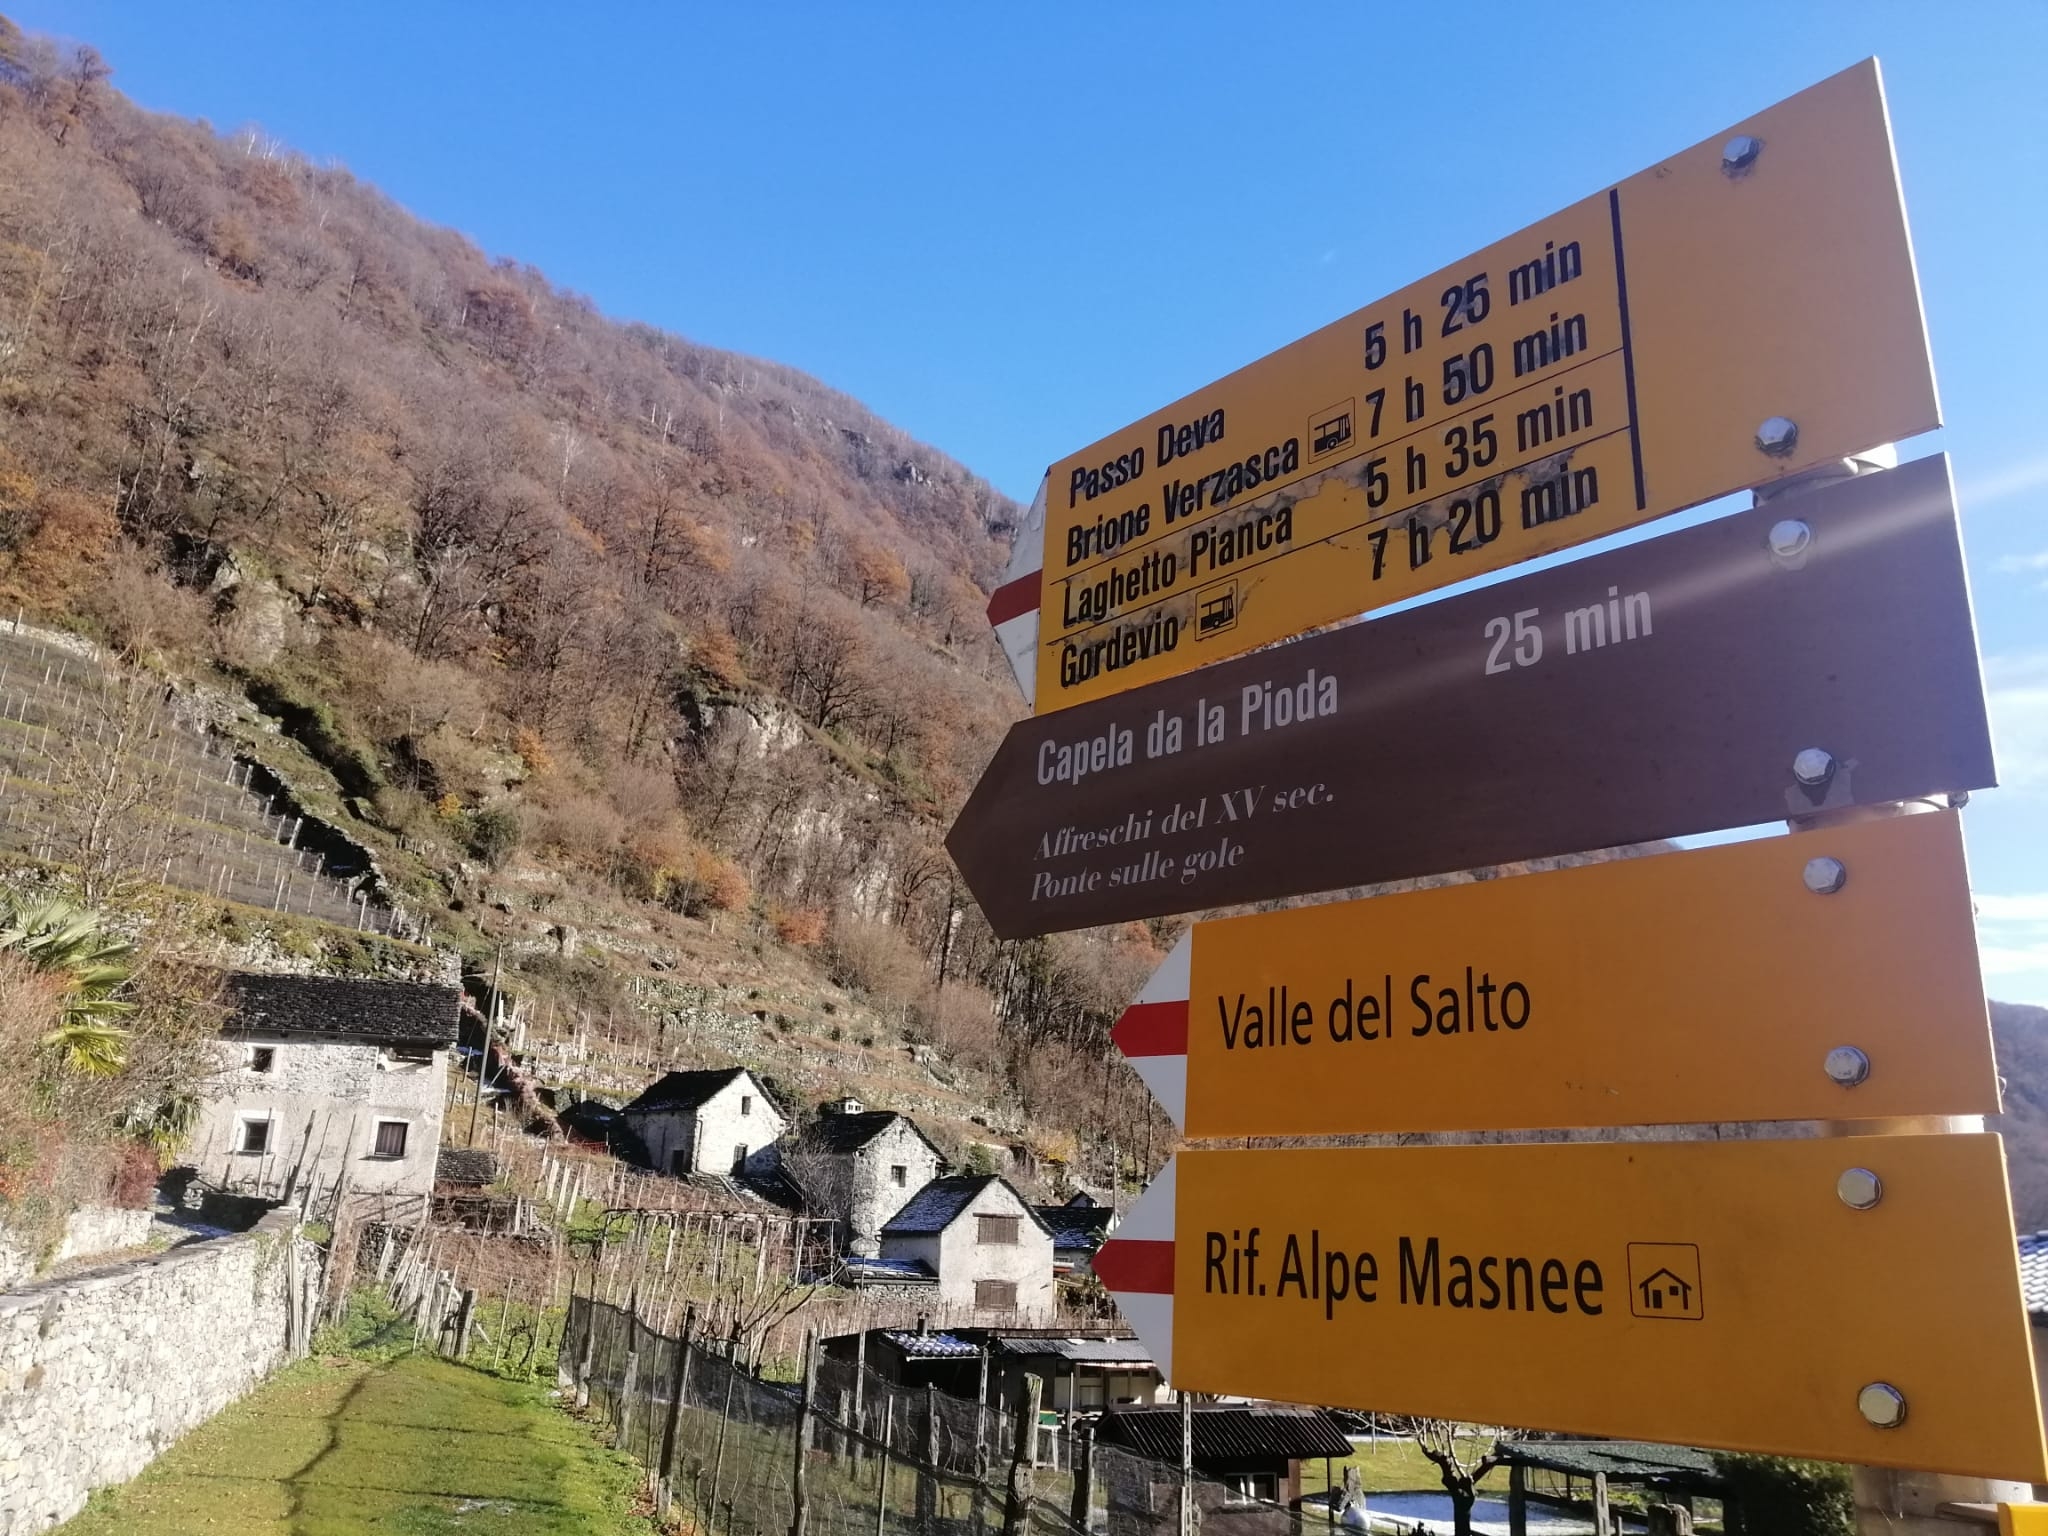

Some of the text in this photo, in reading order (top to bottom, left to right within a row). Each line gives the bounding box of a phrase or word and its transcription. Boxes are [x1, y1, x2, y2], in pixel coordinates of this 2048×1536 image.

[1066, 312, 1587, 567] Brione Verzasca 7 h 50 min
[1069, 240, 1582, 508] Passo Deva 5 h 25 min
[1060, 463, 1599, 689] Gordevio 7 h 20 min
[1062, 387, 1593, 629] Laghetto Pianca 5 h 35 min
[1037, 585, 1652, 786] Capela da la Pioda 25 min
[1031, 837, 1245, 902] Ponte sulle gole
[1033, 778, 1334, 861] Affreschi del XV sec.
[1218, 966, 1531, 1050] Valle del Salto
[1205, 1227, 1603, 1320] Rif. Alpe Masnee
